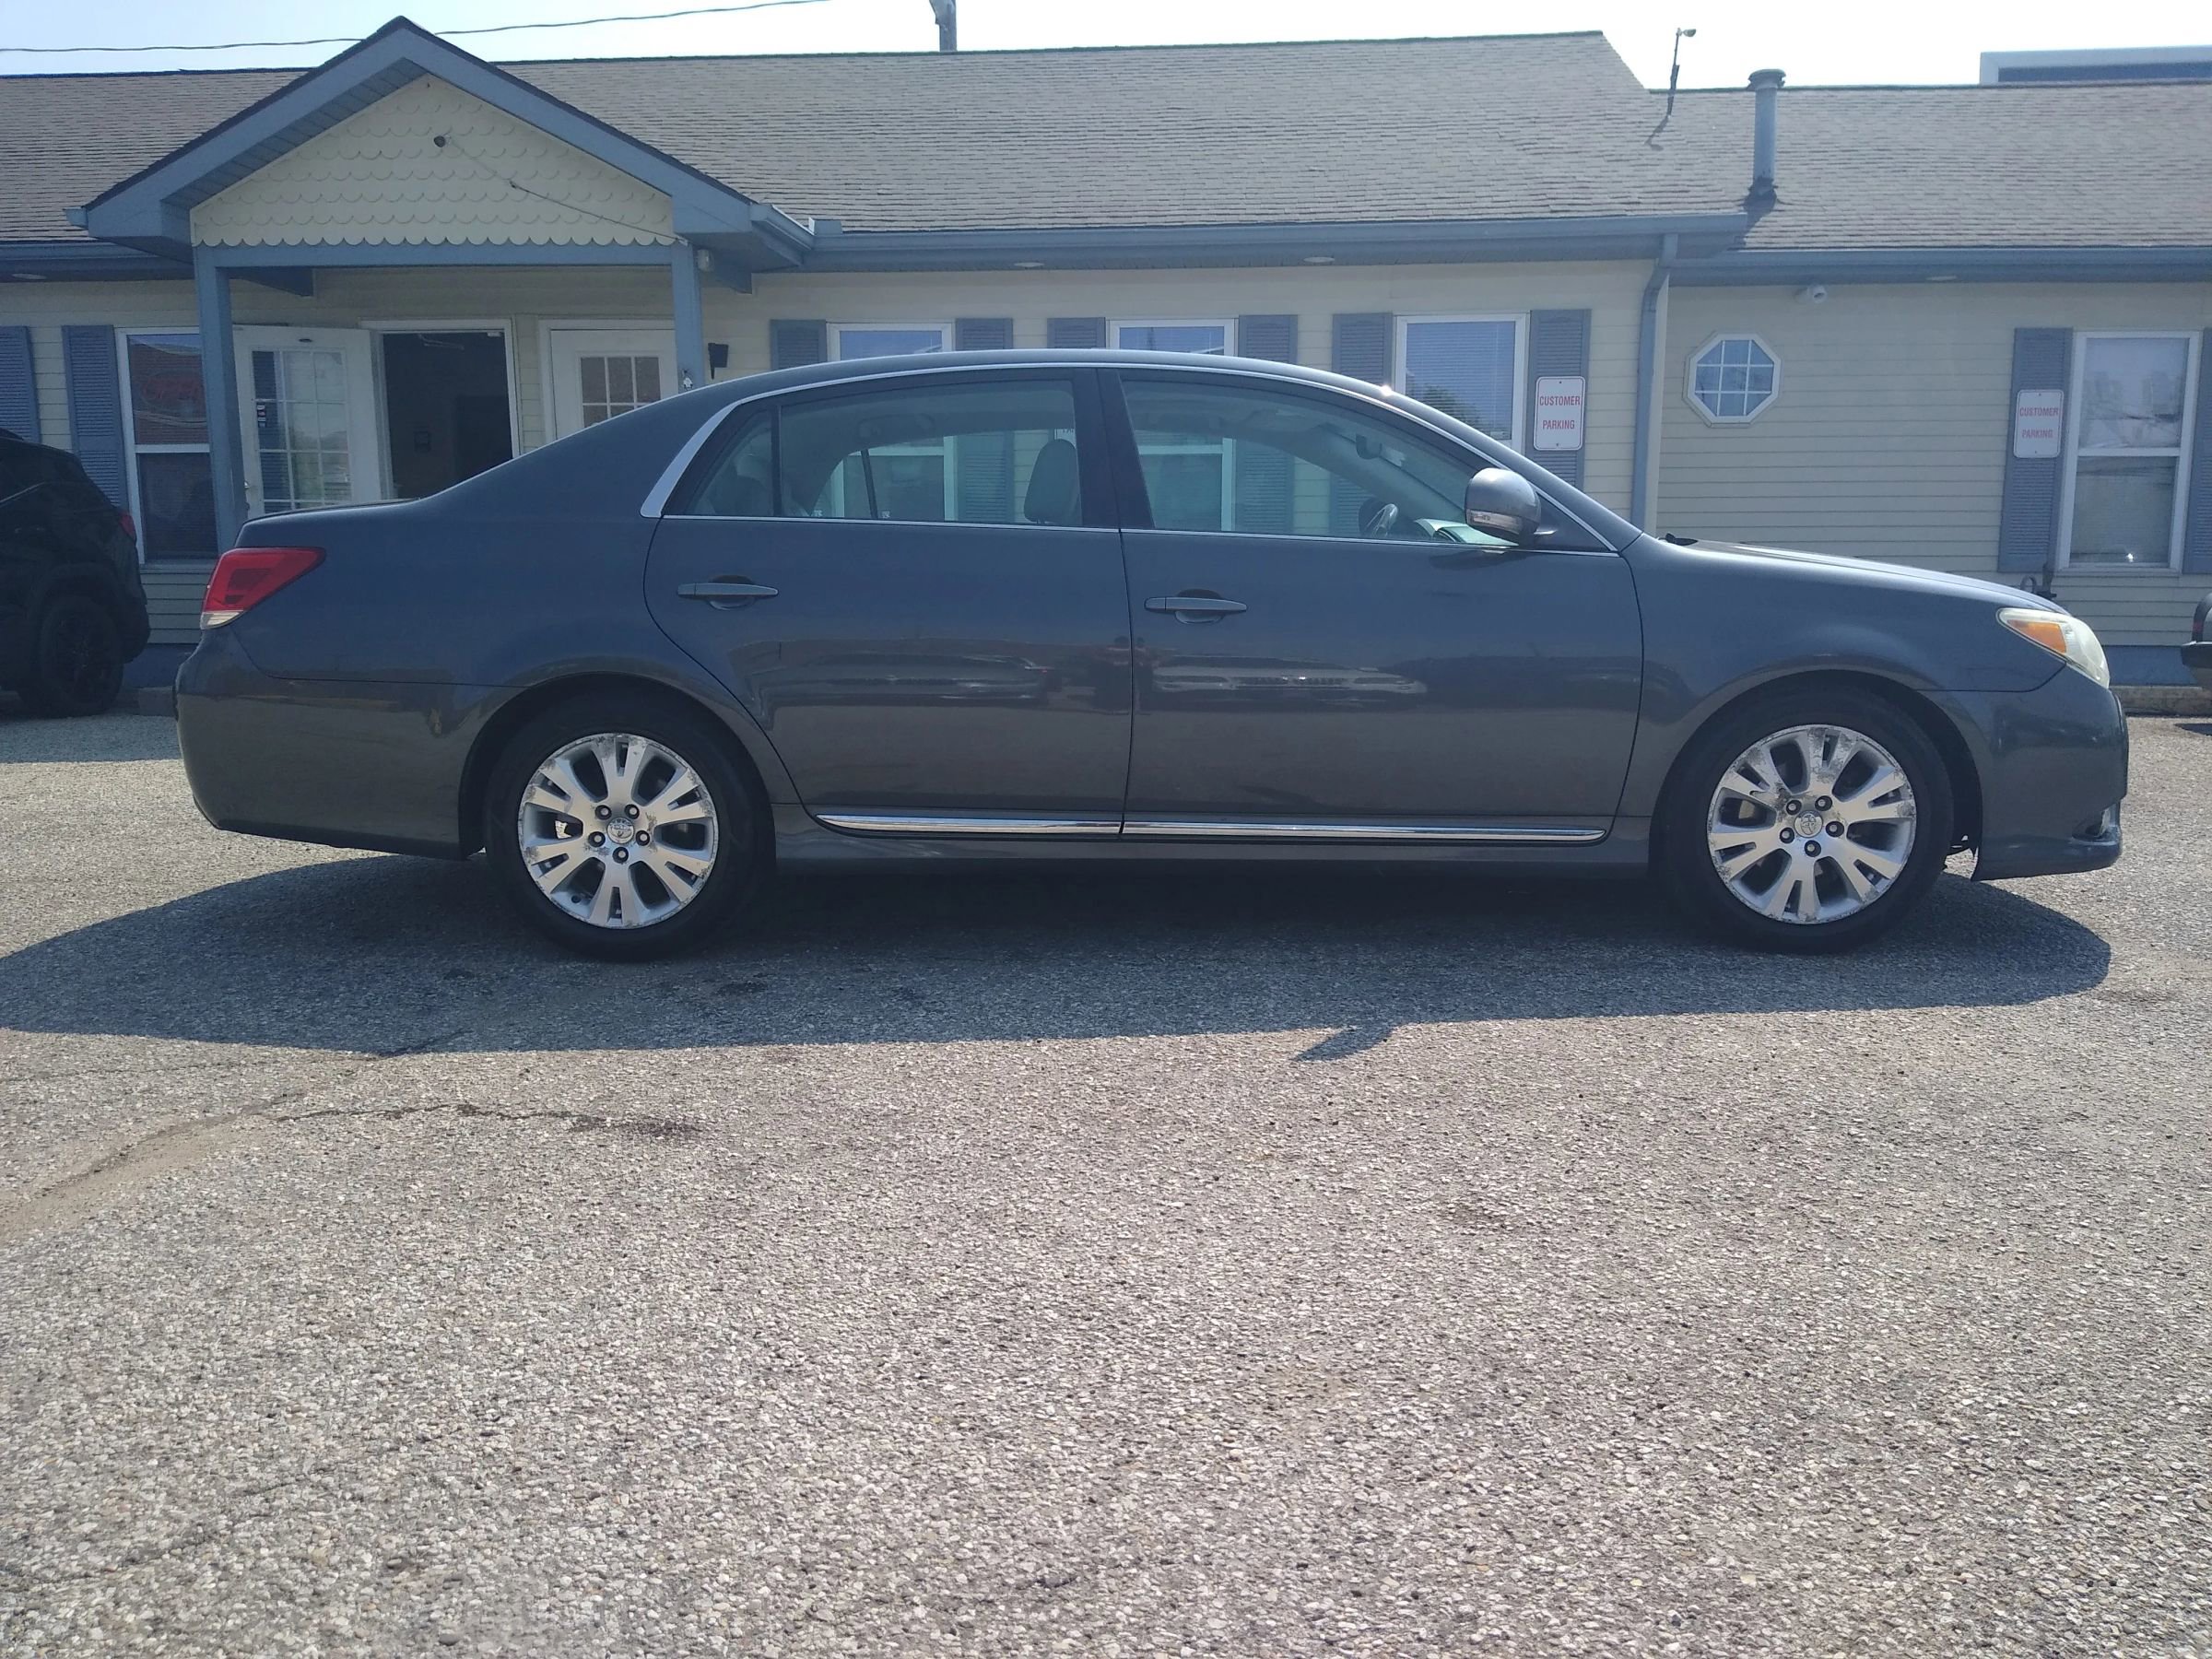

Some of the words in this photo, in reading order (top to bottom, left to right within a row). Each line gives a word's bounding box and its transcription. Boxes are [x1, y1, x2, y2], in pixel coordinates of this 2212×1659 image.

[1539, 395, 1581, 406] CUSTOMER
[2019, 407, 2059, 417] CUSTOMER
[1542, 419, 1575, 430] PARKING
[2021, 429, 2054, 439] PARKING
